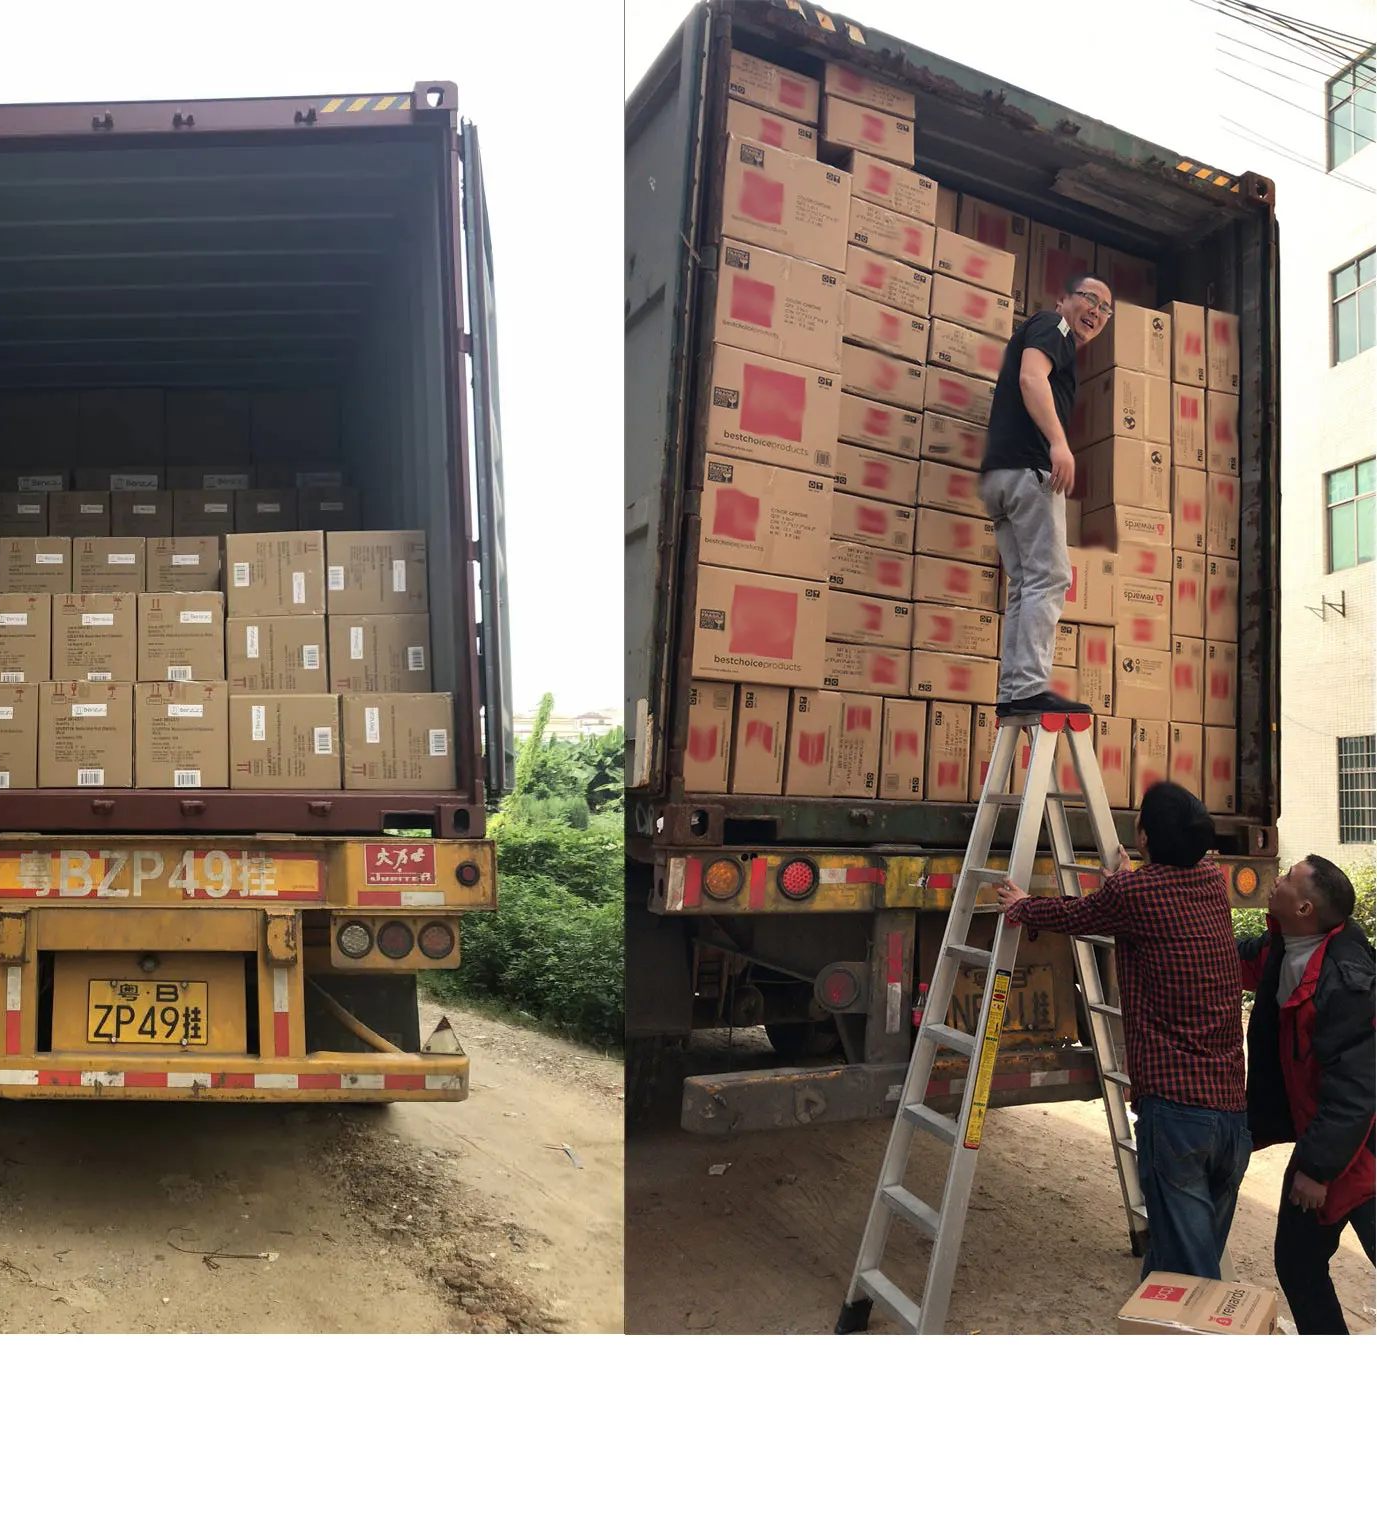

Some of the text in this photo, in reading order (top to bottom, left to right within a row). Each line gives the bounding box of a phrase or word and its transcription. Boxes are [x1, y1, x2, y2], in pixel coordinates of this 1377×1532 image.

[724, 430, 810, 456] bestchoiceproducts
[1125, 519, 1155, 531] rewards
[704, 537, 764, 552] bestchoiceproducts
[1124, 590, 1155, 602] rewards
[714, 655, 802, 672] bestchoiceproducts
[17, 849, 279, 897] 粤BZP49挂
[93, 1004, 202, 1039] ZP49挂
[1221, 1289, 1246, 1317] rewards
